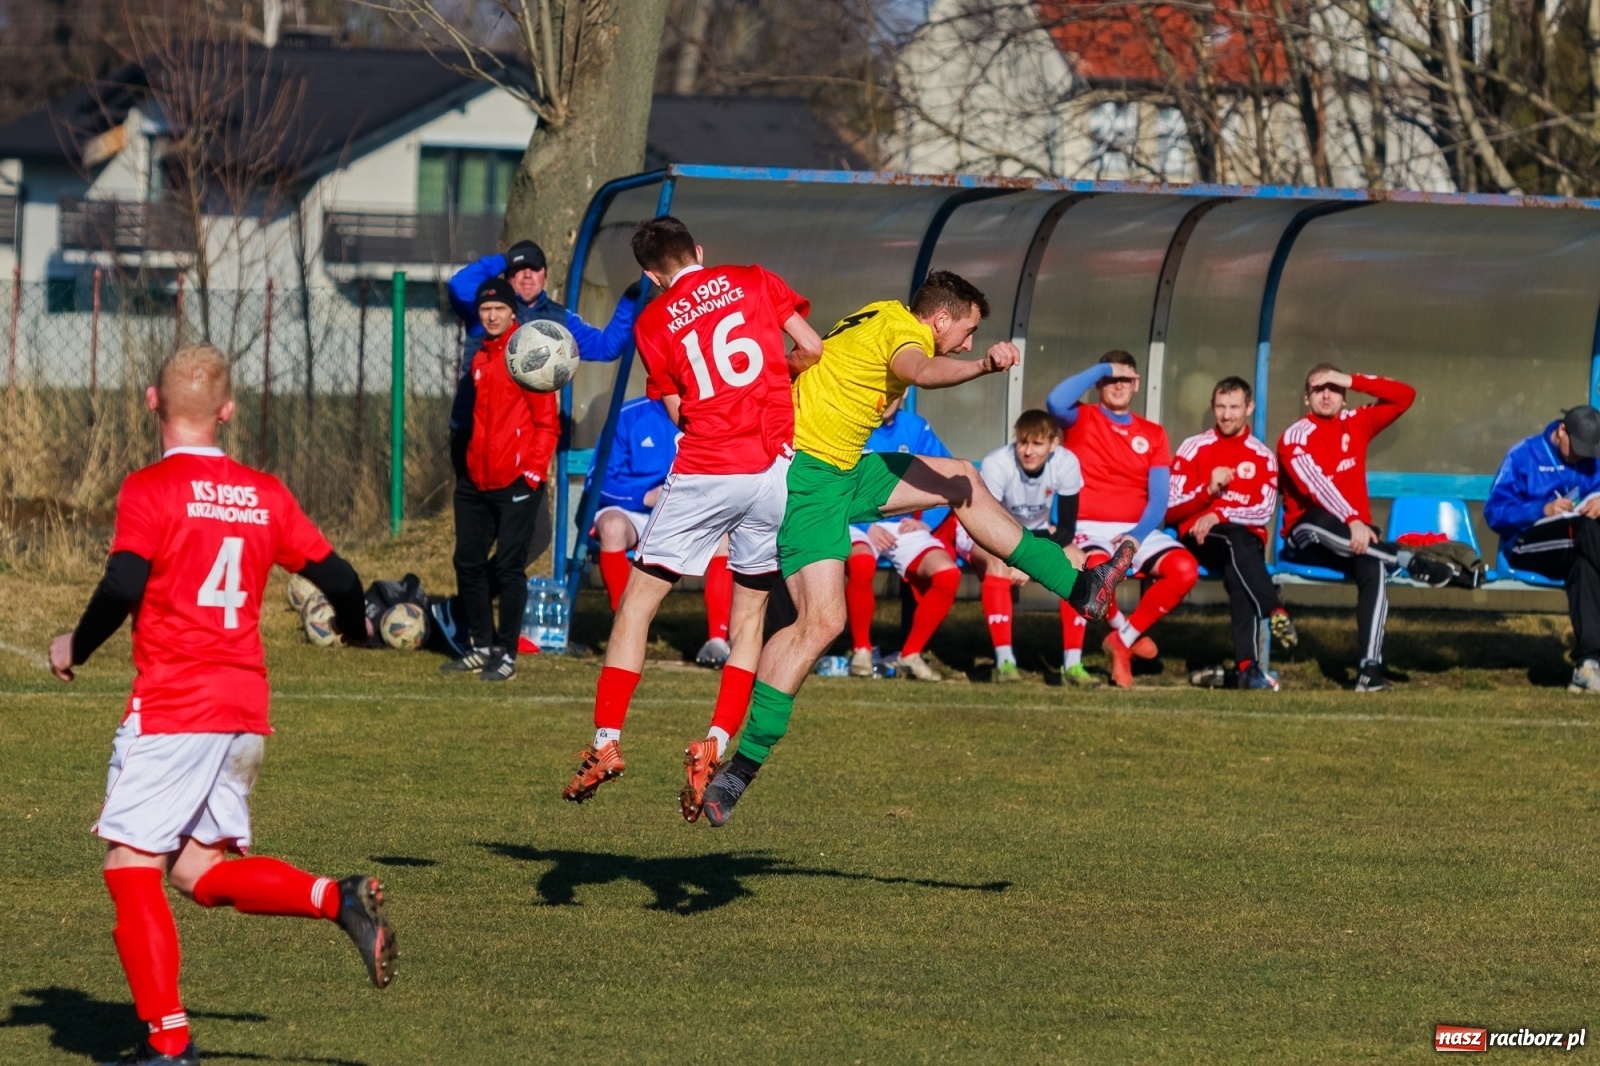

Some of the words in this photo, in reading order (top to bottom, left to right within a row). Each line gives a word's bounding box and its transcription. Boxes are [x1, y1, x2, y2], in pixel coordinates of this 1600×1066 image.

[666, 297, 691, 319] KS
[693, 274, 731, 303] 1905
[667, 286, 745, 334] KRZANOWICE
[681, 311, 764, 401] 16
[186, 502, 270, 526] KRZANOWICE
[190, 480, 216, 502] KS
[216, 483, 259, 508] 1905
[197, 536, 249, 630] 4
